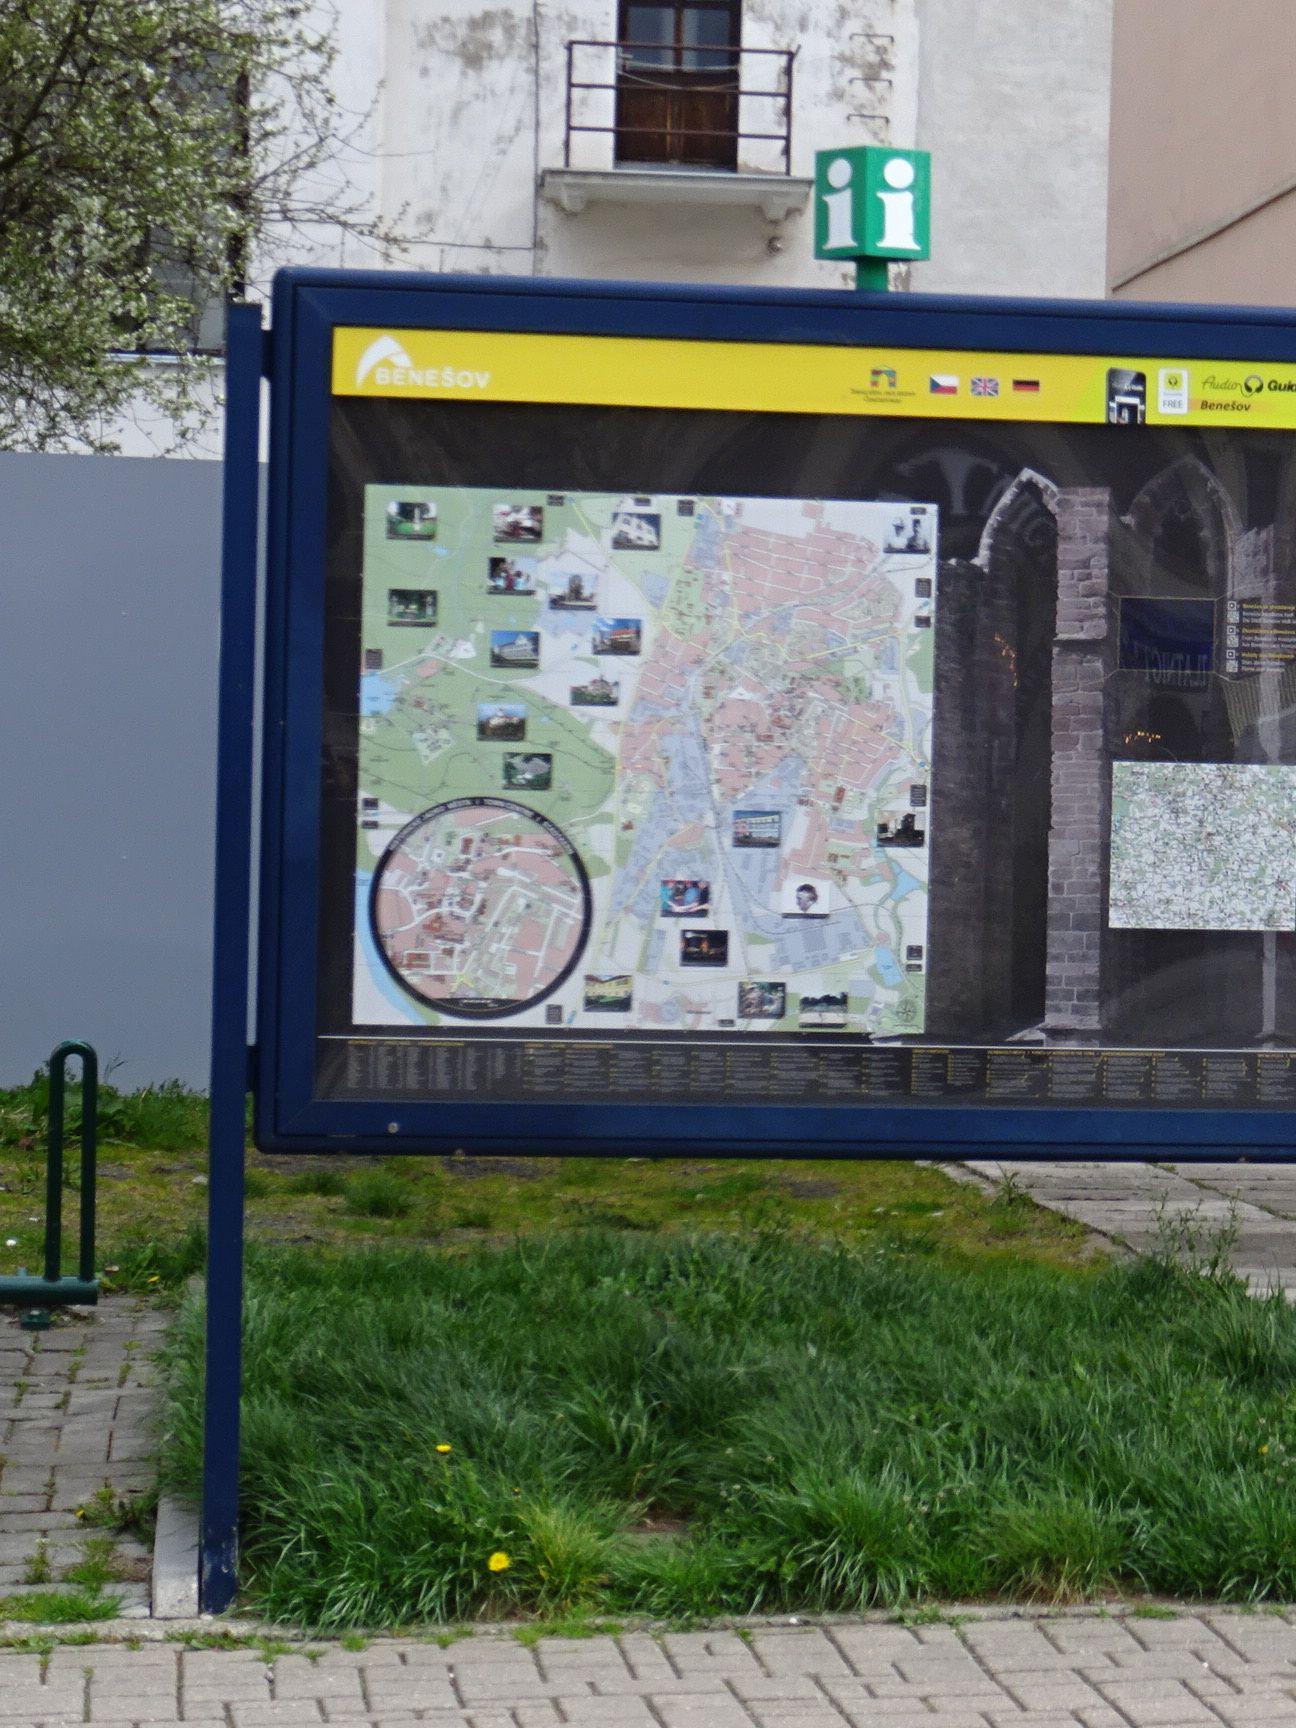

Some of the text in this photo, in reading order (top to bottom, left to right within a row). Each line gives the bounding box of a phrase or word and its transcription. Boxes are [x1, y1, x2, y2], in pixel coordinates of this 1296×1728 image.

[375, 366, 492, 389] BENEŠOV
[1201, 374, 1240, 391] Audio
[1162, 399, 1184, 409] FREE
[1200, 399, 1252, 412] Benešov
